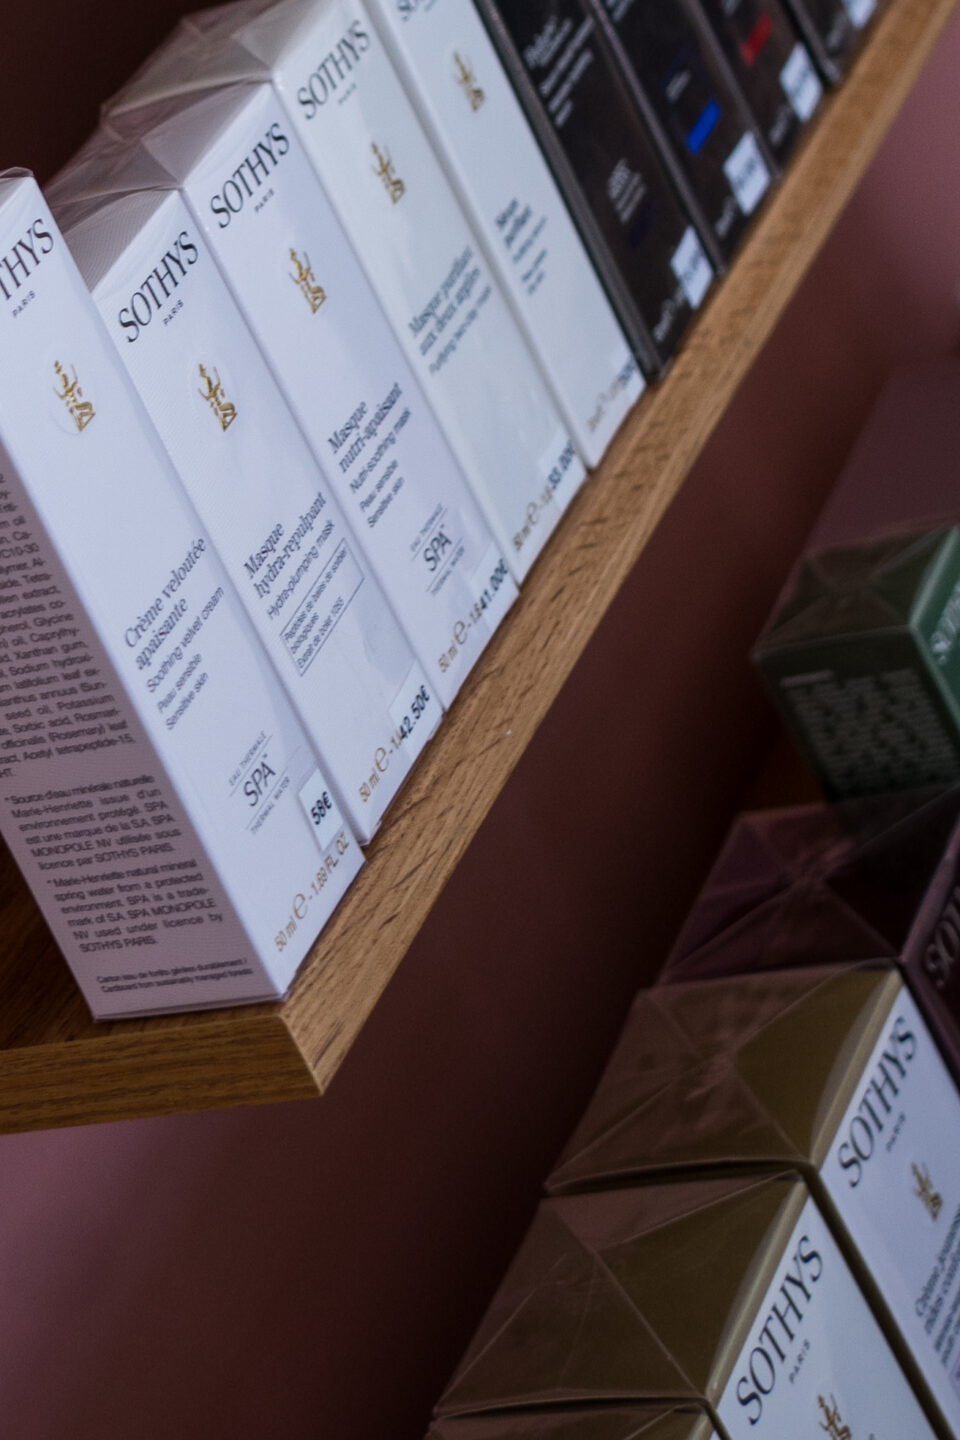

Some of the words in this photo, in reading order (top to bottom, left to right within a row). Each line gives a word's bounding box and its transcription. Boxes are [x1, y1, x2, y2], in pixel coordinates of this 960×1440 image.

[297, 19, 369, 120] SOTHYS
[210, 122, 289, 229] SOTHYS
[11, 289, 35, 317] PARIS
[118, 230, 198, 343] SOTHYS
[162, 298, 184, 325] PARIS
[326, 400, 367, 454] Masque
[338, 381, 403, 473] nutri-apaisant
[242, 522, 283, 579] Masque
[252, 491, 327, 599] hydra-repulpant
[266, 544, 319, 620] Hydra-plumping
[315, 519, 335, 547] mask
[124, 597, 163, 648] Crème
[161, 537, 206, 599] veloutée
[135, 597, 187, 670] apaisante
[146, 645, 183, 693] Soothing
[179, 615, 203, 648] velvet
[200, 585, 224, 620] cream
[156, 687, 177, 713] Peau
[174, 653, 202, 691] sensible
[164, 689, 195, 730] Sensitive
[193, 671, 208, 693] skin
[398, 684, 430, 741] 42.50€
[243, 753, 276, 807] SPA
[310, 790, 332, 825] 58€
[29, 840, 94, 857] MONOPOLE
[93, 847, 140, 863] SOTHYS
[86, 886, 114, 897] water
[78, 938, 123, 953] SOTHYS
[93, 926, 122, 938] used
[125, 922, 158, 933] under
[838, 1016, 918, 1189] SOTHYS
[735, 1235, 823, 1427] SOTHYS
[788, 1339, 811, 1386] PARIS
